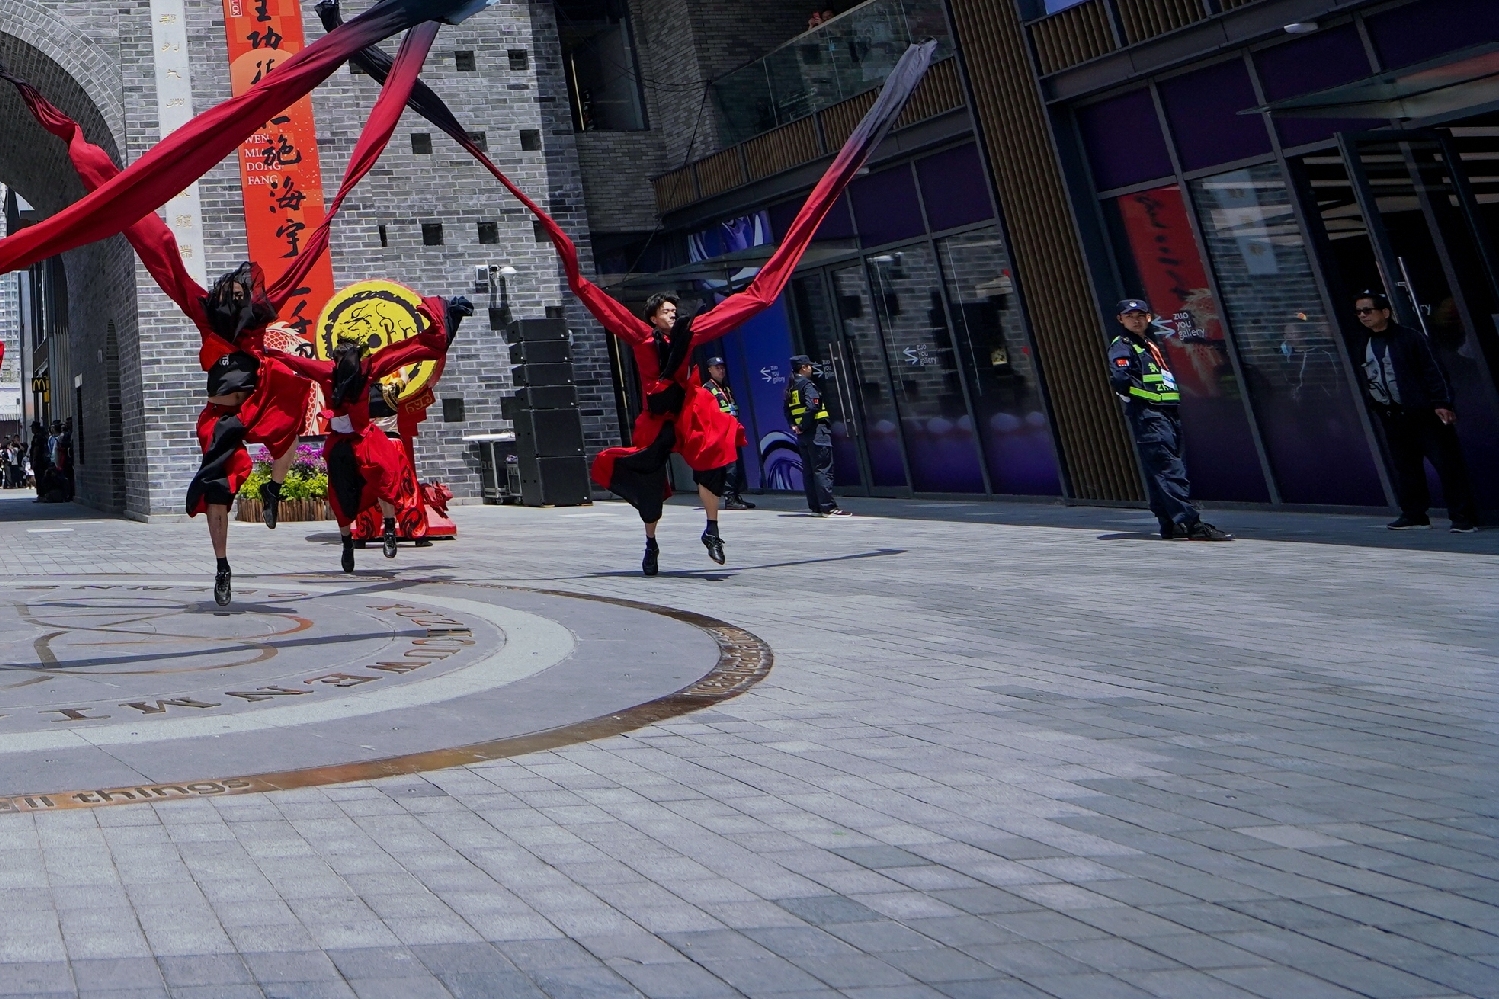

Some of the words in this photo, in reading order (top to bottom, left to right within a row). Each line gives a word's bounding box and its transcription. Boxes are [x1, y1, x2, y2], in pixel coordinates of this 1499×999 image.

[244, 134, 270, 144] WEN
[248, 175, 278, 185] FANG
[1175, 320, 1192, 330] you
[1177, 328, 1205, 341] gallery
[72, 777, 251, 802] things
